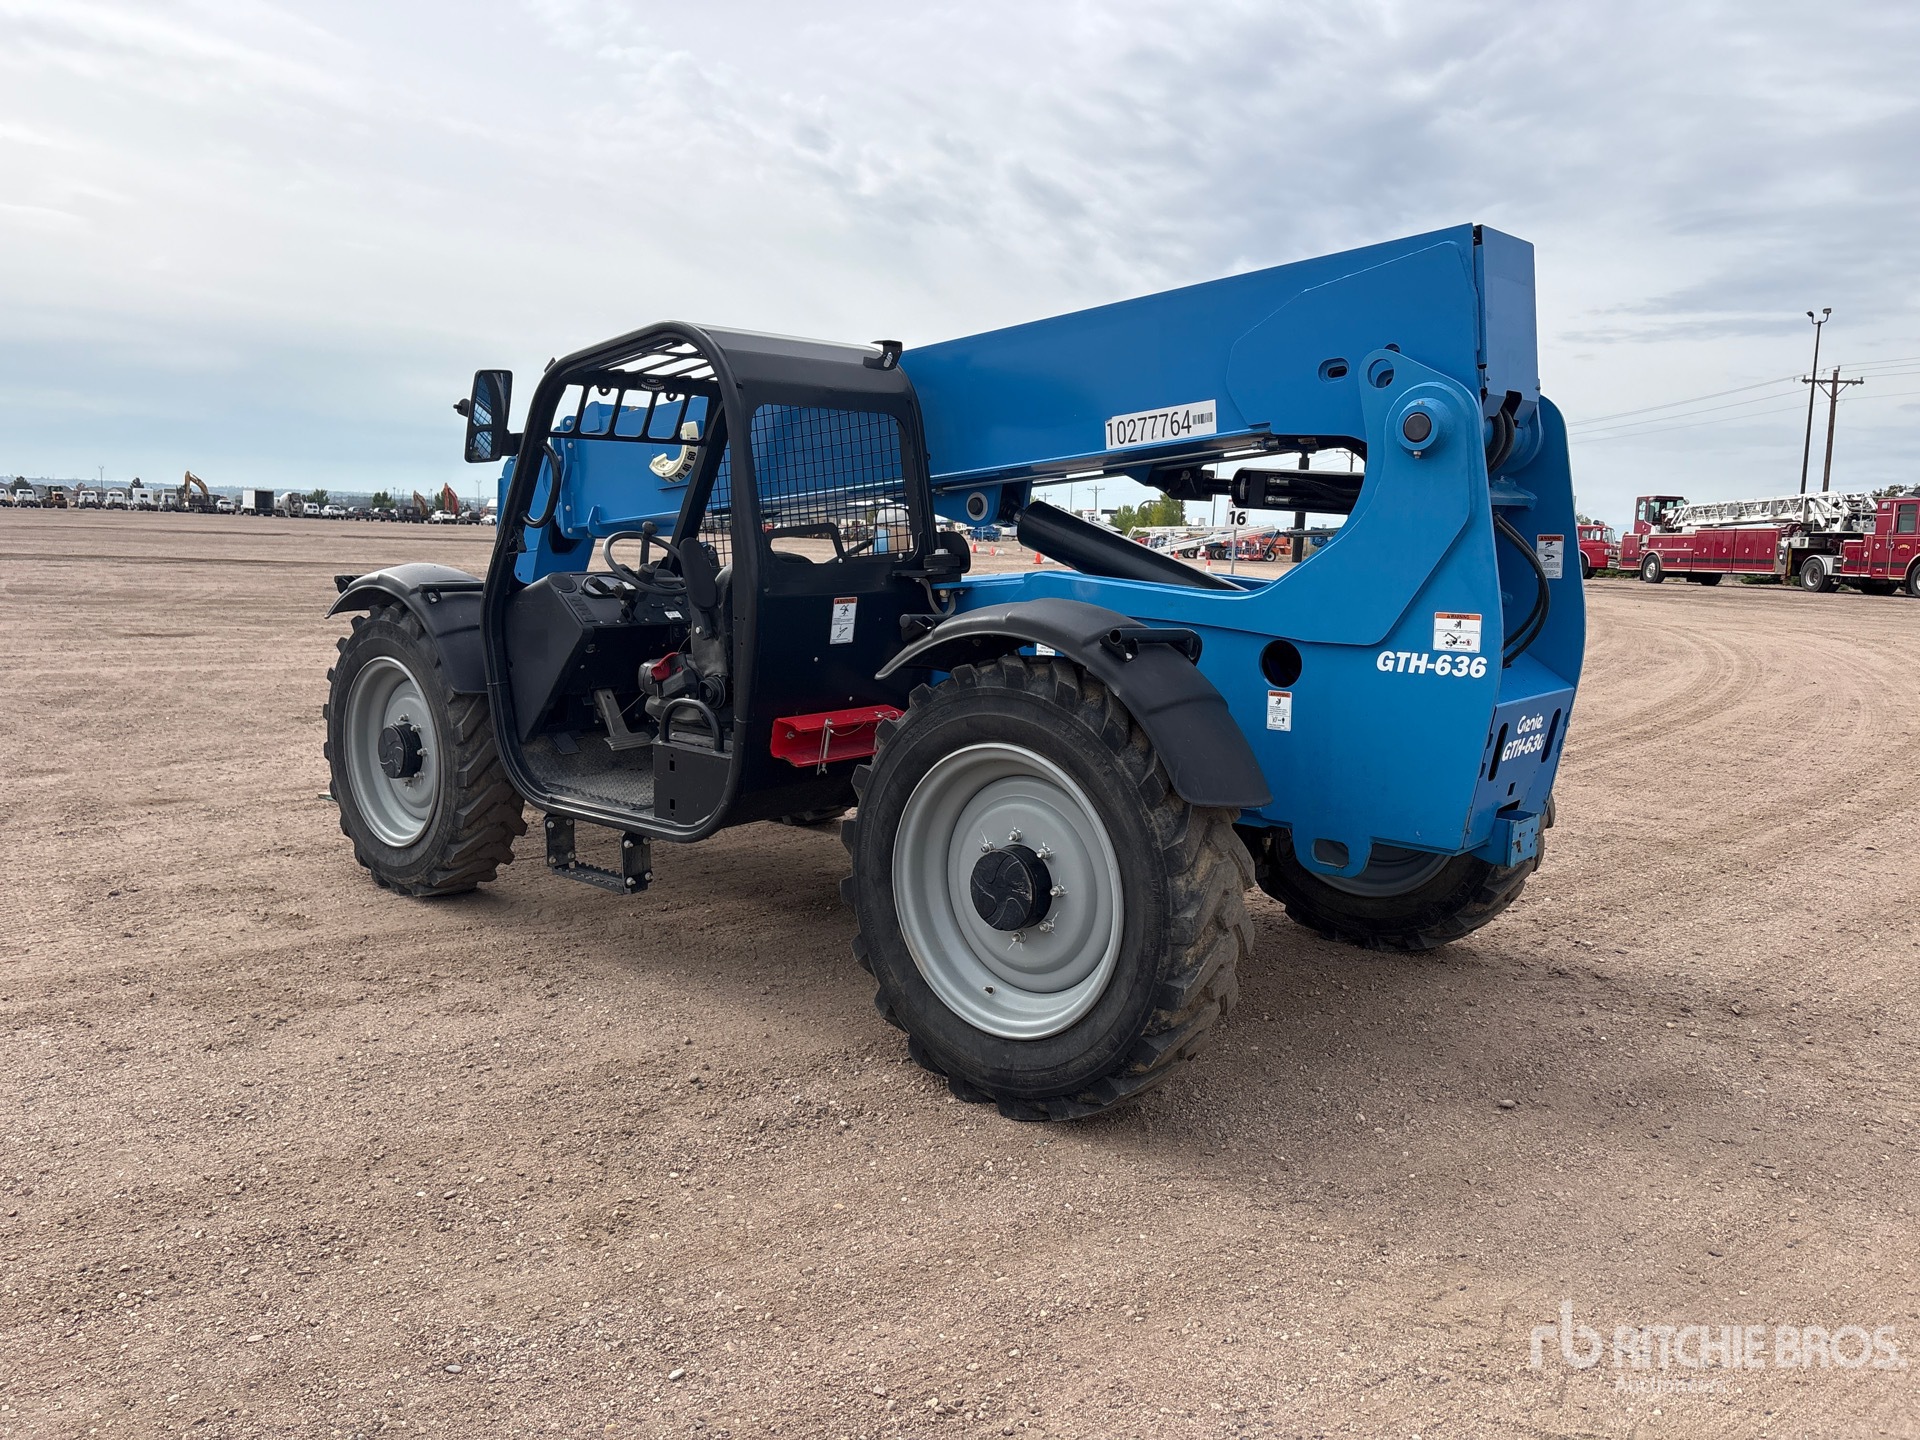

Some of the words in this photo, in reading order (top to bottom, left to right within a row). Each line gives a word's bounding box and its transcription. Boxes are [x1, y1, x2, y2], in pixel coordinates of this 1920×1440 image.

[1107, 409, 1192, 446] 10277764
[1229, 510, 1246, 526] 16
[1376, 650, 1488, 679] GTH-636
[1517, 712, 1544, 735] Genie
[1501, 733, 1546, 762] GTH-636
